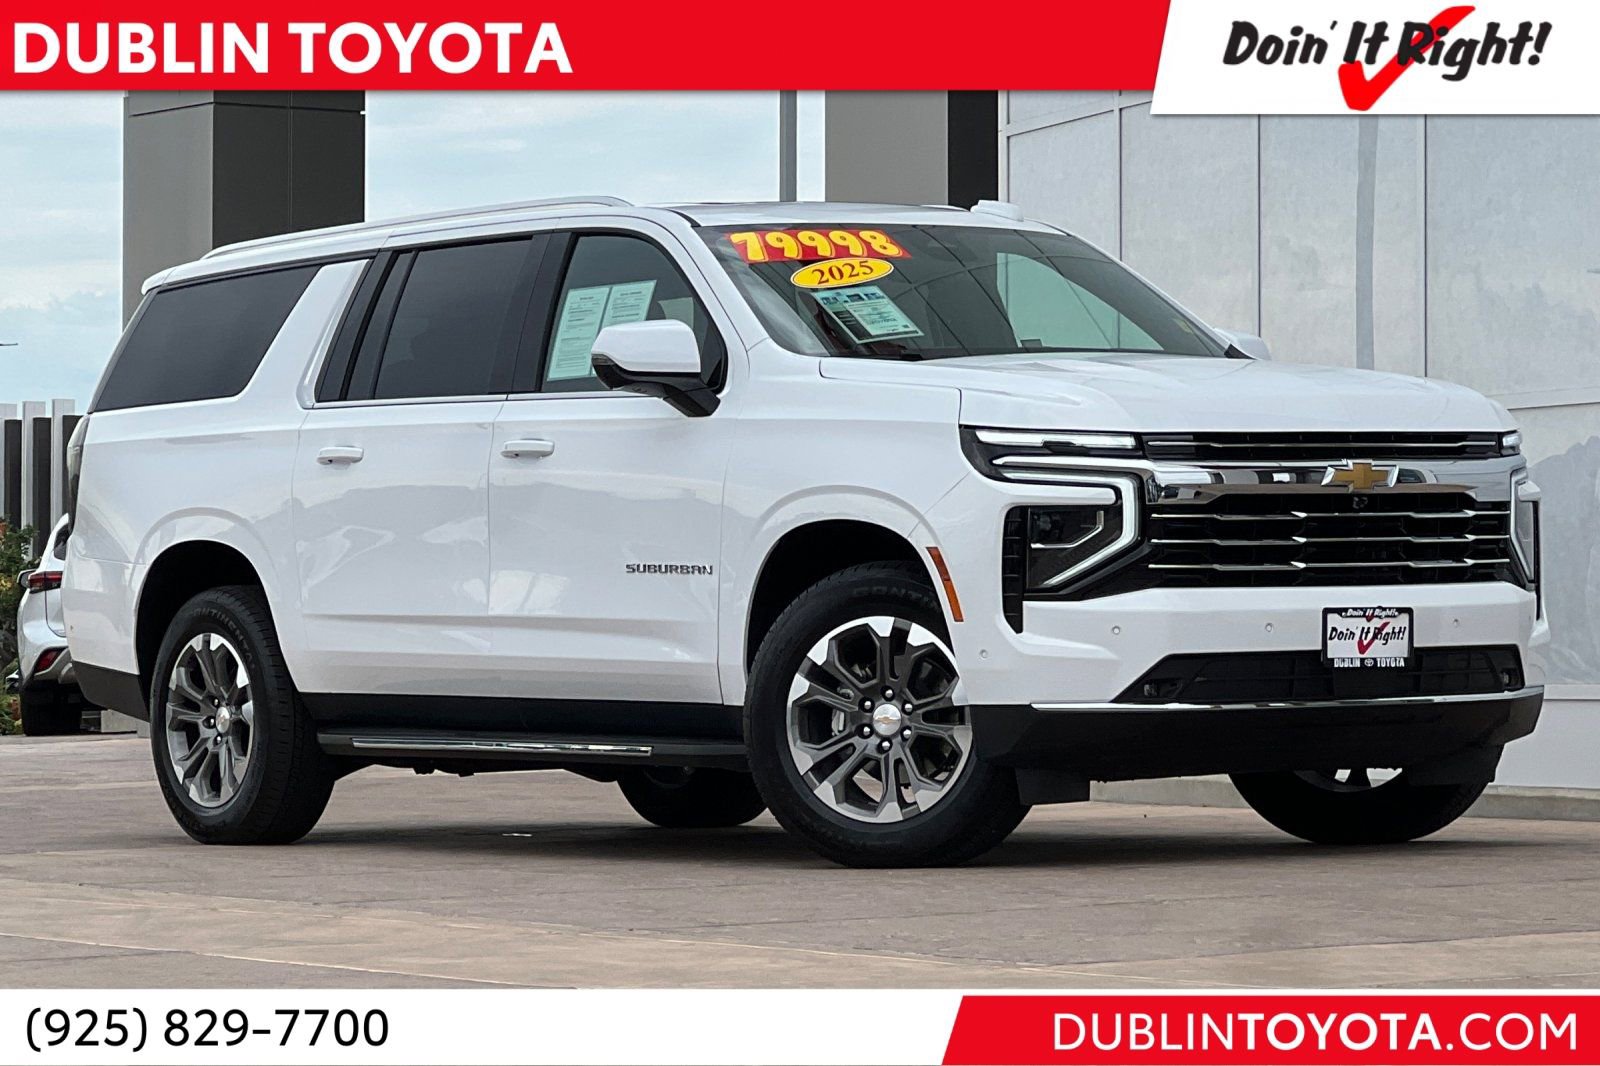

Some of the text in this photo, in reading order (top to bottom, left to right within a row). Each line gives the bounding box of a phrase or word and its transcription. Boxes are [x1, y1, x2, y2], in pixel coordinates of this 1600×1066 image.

[730, 230, 904, 262] 79998
[812, 259, 875, 286] 2025
[625, 563, 714, 576] SUBURBAN
[1328, 626, 1407, 645] Doin' It Right!
[1333, 657, 1405, 668] DUBLIN TOYOTA
